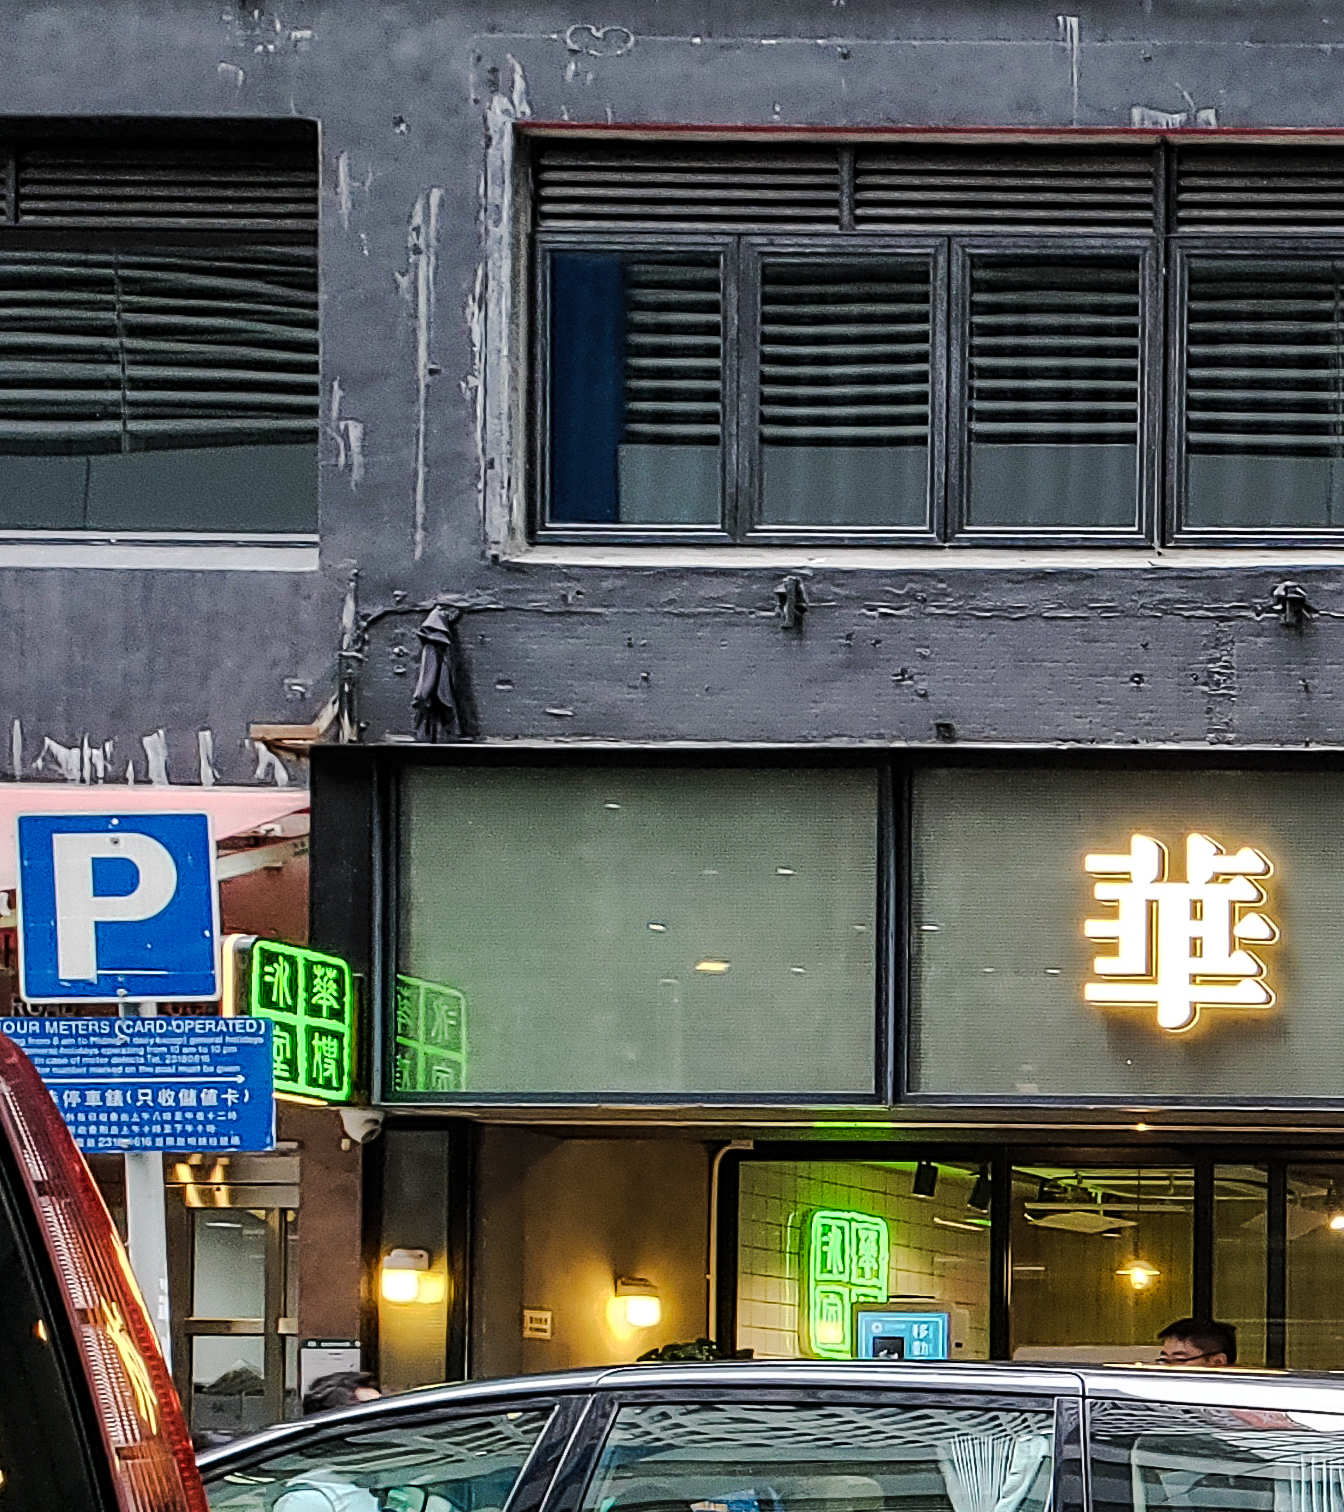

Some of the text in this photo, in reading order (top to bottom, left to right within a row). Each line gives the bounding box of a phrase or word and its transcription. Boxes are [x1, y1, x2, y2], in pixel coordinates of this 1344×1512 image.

[52, 832, 178, 984] P
[0, 1019, 266, 1036] OUR METERS (CARD-OPERATED)
